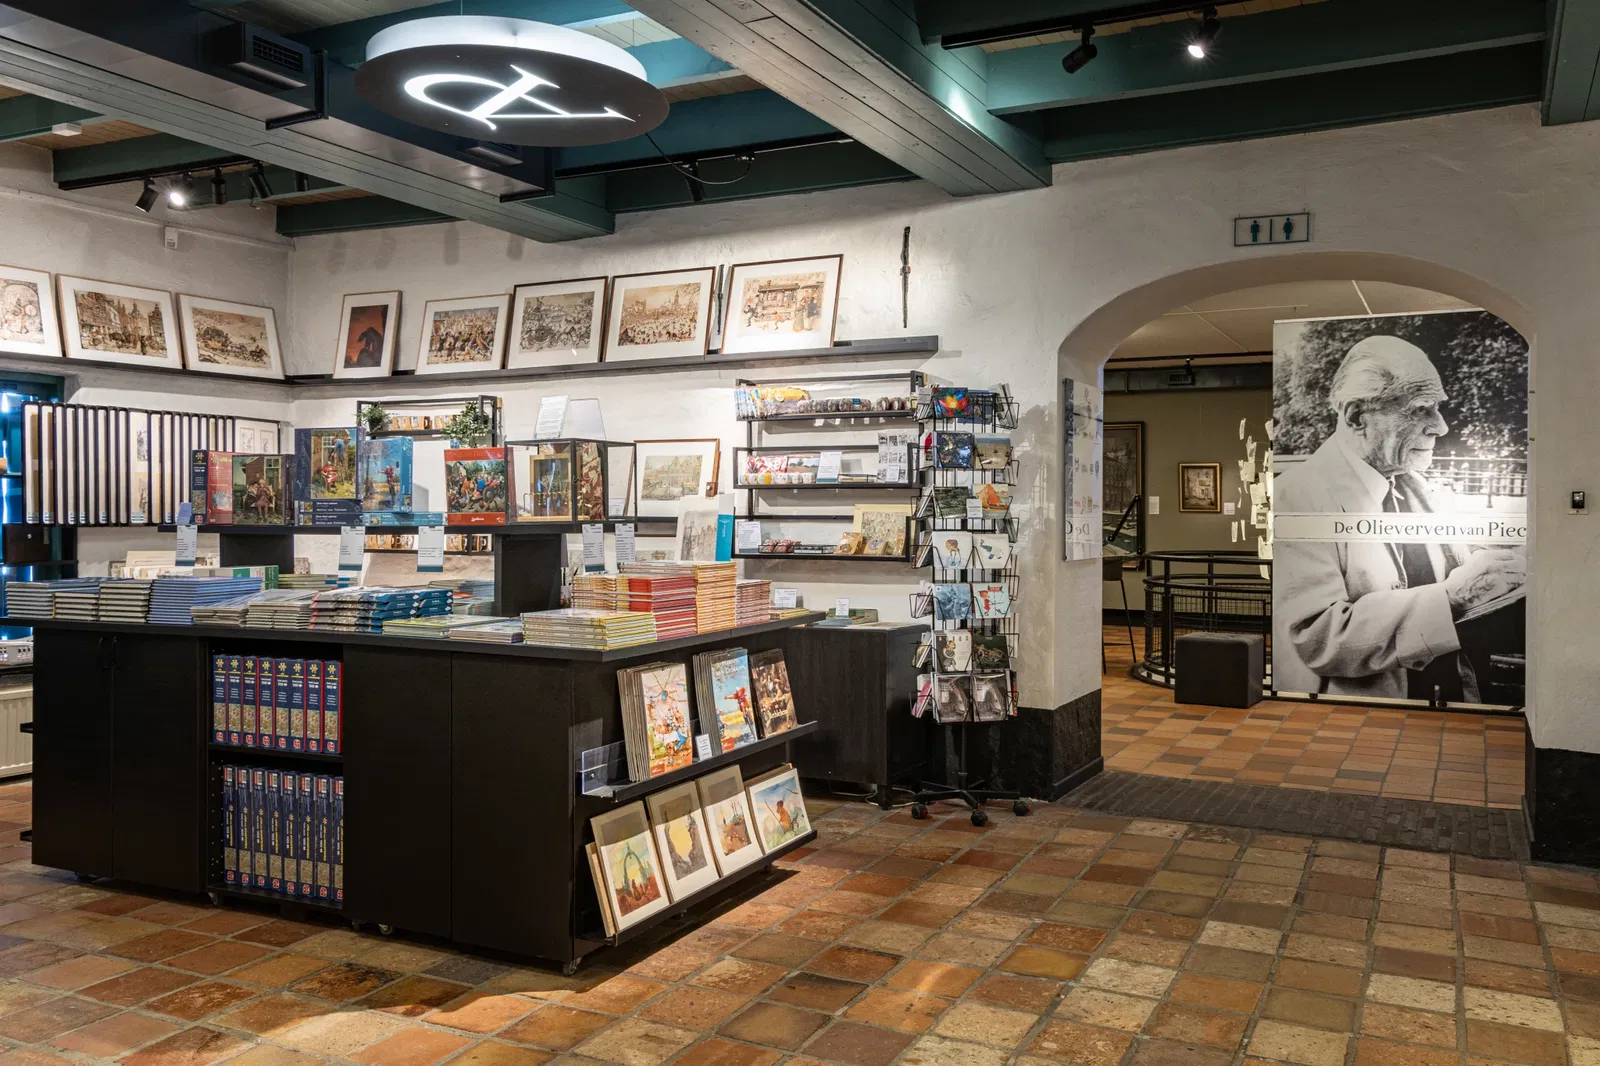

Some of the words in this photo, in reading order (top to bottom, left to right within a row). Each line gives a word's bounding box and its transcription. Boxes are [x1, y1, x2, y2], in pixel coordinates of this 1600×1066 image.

[1334, 521, 1353, 534] De
[1356, 519, 1456, 536] Olieverven
[1460, 525, 1484, 536] van
[1488, 521, 1527, 537] Piec
